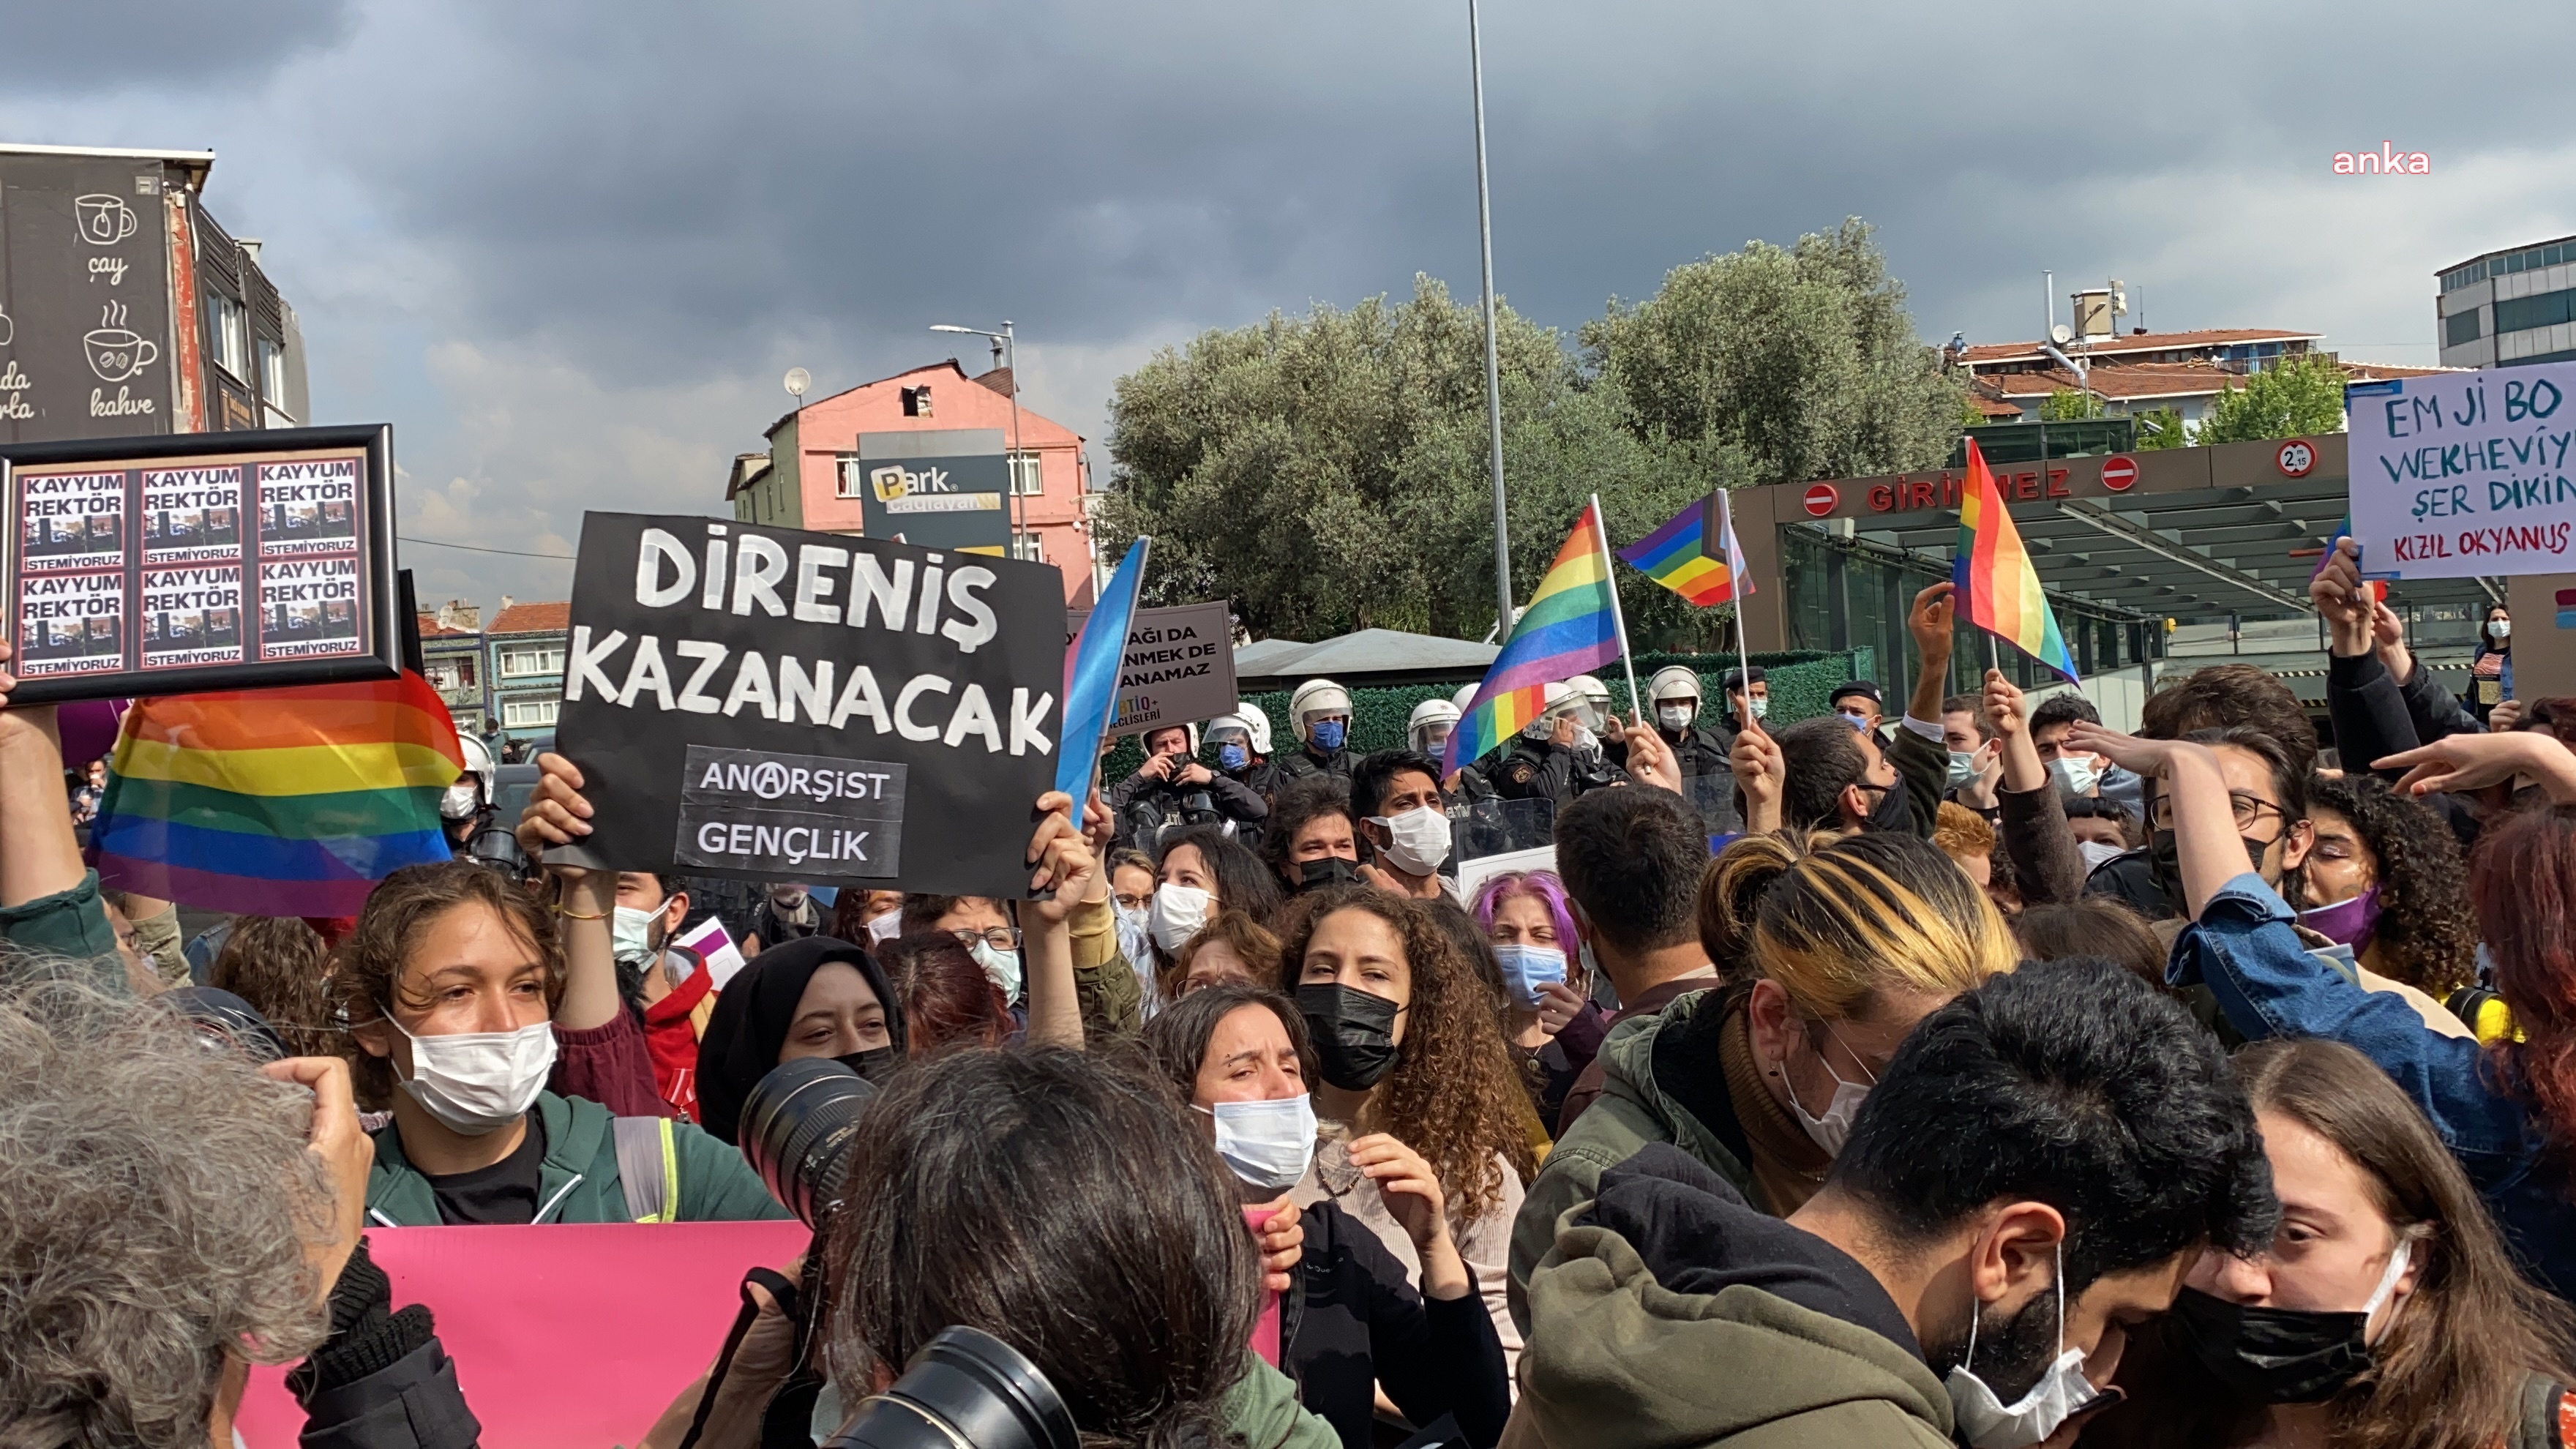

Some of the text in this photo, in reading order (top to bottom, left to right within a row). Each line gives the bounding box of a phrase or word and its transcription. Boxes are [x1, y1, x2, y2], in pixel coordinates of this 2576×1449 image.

[89, 257, 128, 285] çay
[0, 360, 31, 390] da
[90, 386, 155, 417] kahve
[2386, 394, 2442, 438] EM
[2506, 378, 2563, 422] BO
[2380, 425, 2576, 484] WEKHEVÎY
[145, 468, 239, 488] KAYYUM
[261, 462, 353, 481] KAYYUM
[881, 466, 950, 496] Park
[26, 475, 123, 494] KAYYUM
[261, 479, 352, 502] REKTÖR
[25, 493, 121, 517] REKTÖR
[145, 487, 238, 510] REKTÖR
[2411, 484, 2475, 523] ŞER
[261, 539, 355, 555] İSTEMİYORUZ
[2394, 522, 2571, 562] KIZIL OKYANUS
[24, 554, 121, 571] İSTEMİYORUZ
[144, 547, 239, 564] İSTEMİYORUZ
[144, 567, 240, 588] KAYYUM
[261, 560, 356, 580] KAYYUM
[23, 575, 122, 595] KAYYUM
[261, 578, 355, 603] REKTÖR
[635, 523, 997, 654] DİRENİŞ
[23, 594, 120, 618] REKTÖR
[145, 587, 239, 612] REKTÖR
[1127, 626, 1197, 645] AĞI DA
[144, 648, 240, 666] İSTEMİYORUZ
[263, 640, 357, 657] İSTEMİYORUZ
[1122, 643, 1216, 667] NMEK DE
[22, 658, 120, 675] İSTEMİYORUZ
[1120, 662, 1210, 688] ANAMAZ
[566, 626, 1053, 756] KAZANACAK
[700, 761, 890, 802] ANARŞİST
[697, 822, 870, 864] GENÇLİK
